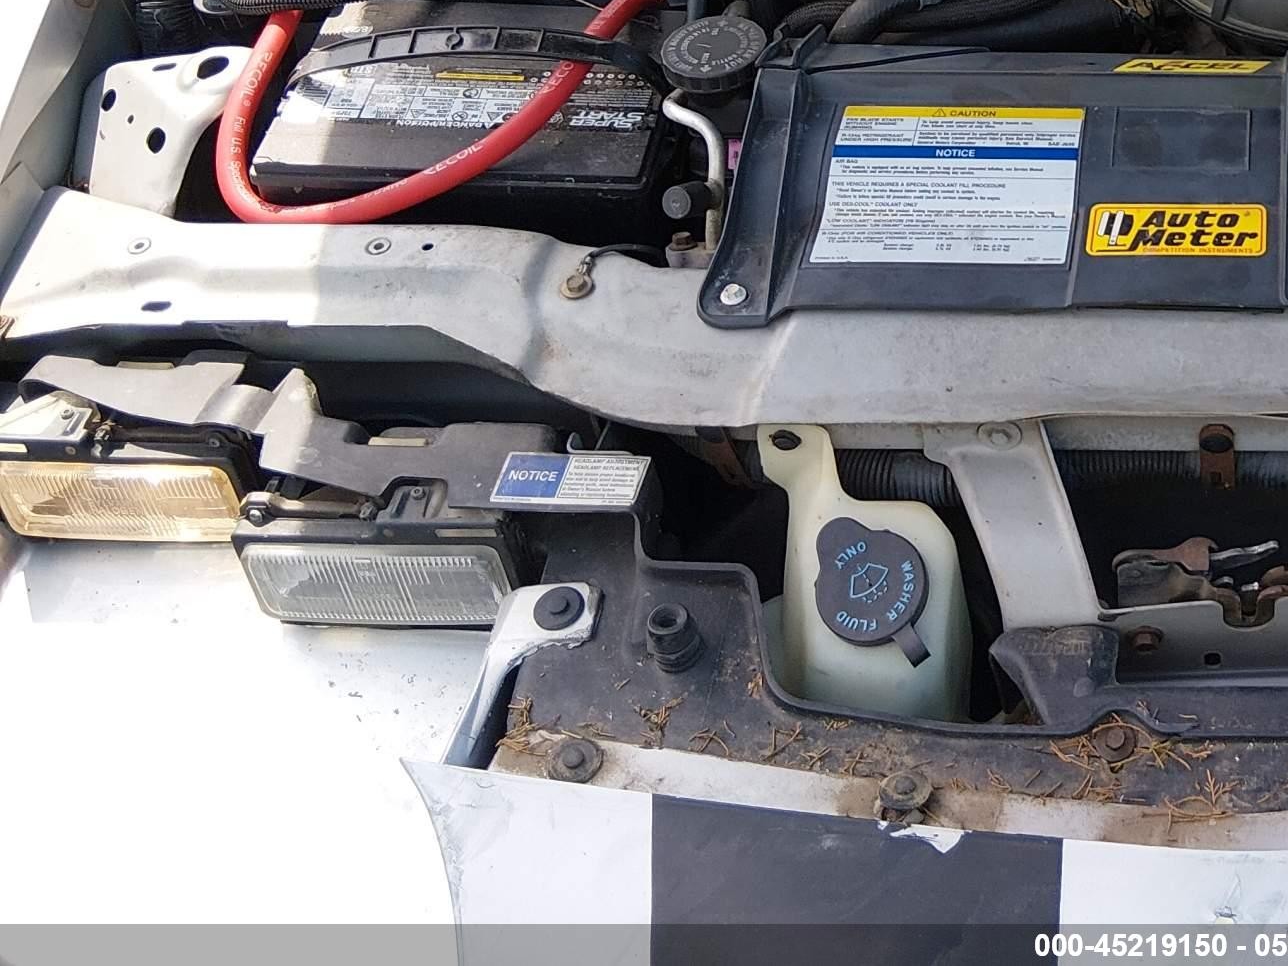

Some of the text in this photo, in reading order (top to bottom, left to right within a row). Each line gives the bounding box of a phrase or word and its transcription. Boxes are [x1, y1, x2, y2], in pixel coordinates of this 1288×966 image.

[570, 109, 646, 123] START
[950, 110, 997, 118] CAUTION
[568, 117, 635, 129] SUPER
[935, 148, 977, 158] NOTICE
[1140, 210, 1240, 229] Auto
[1133, 228, 1259, 247] Meter
[1142, 246, 1196, 254] COMPETITION
[508, 469, 559, 482] NOTICE
[834, 541, 867, 570] ONLY
[836, 560, 915, 631] WASHER FLUID
